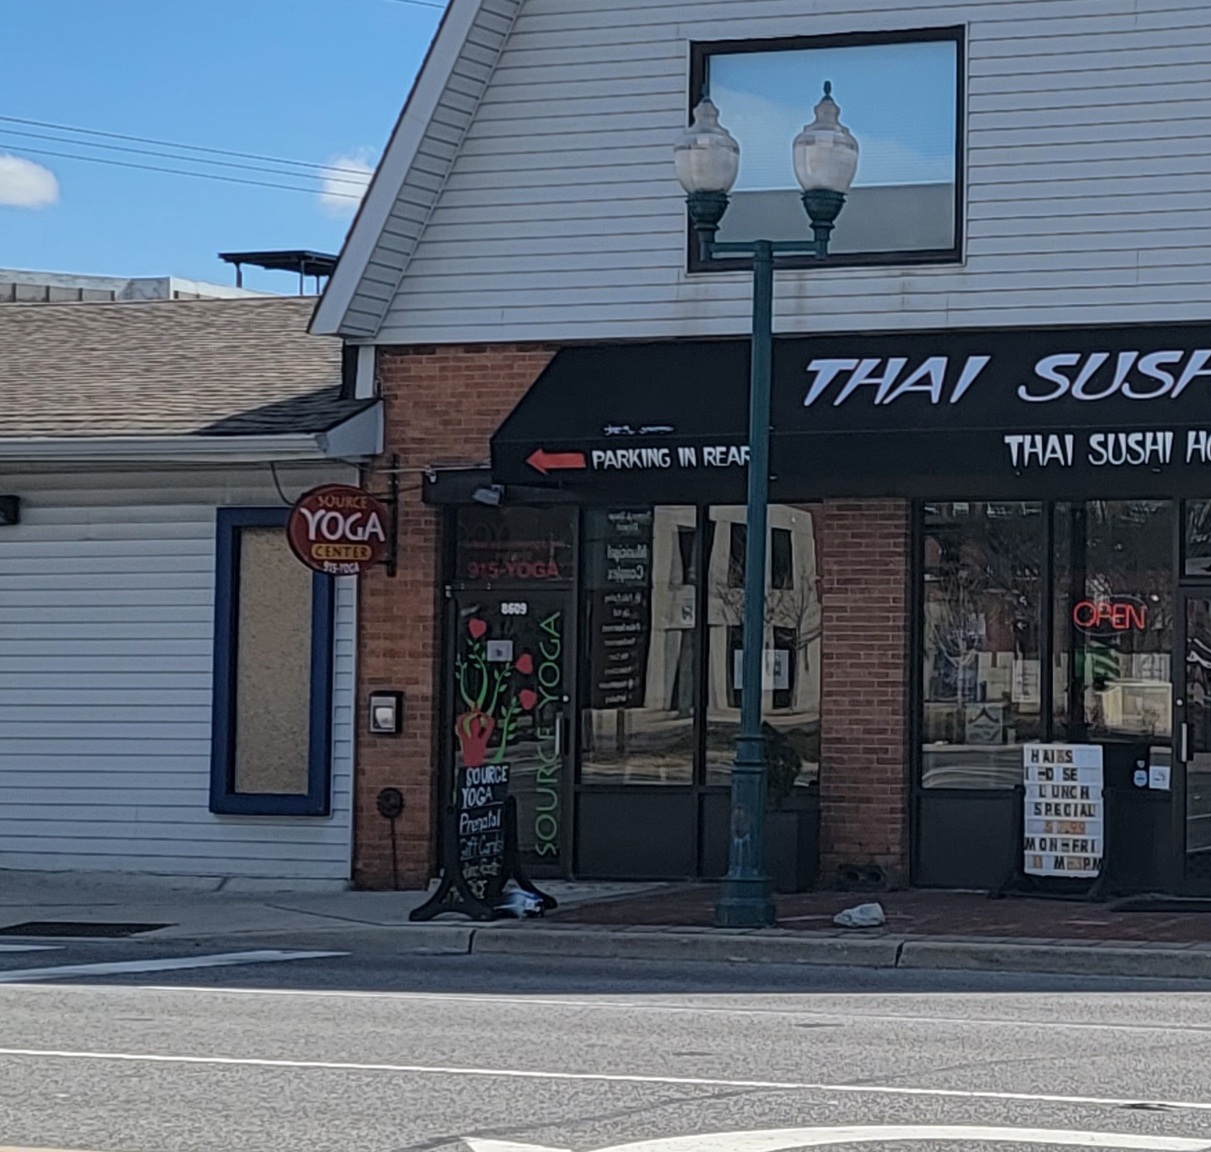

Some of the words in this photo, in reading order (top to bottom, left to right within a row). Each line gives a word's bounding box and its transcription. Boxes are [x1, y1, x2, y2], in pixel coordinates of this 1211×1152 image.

[803, 356, 991, 406] THAI
[592, 448, 671, 469] PARKING
[678, 447, 697, 468] IN
[1004, 434, 1074, 467] THAI
[1088, 432, 1174, 465] SUSHI
[318, 496, 367, 508] SOURCE
[300, 508, 386, 542] YOGA
[315, 546, 369, 558] CENTER
[501, 602, 527, 615] 8609
[1073, 601, 1145, 630] OPEN
[538, 611, 561, 709] YOGA
[466, 765, 509, 786] SOURCE
[461, 786, 493, 809] YOGA
[535, 727, 561, 856] SOURCE
[1039, 785, 1090, 799] LUNCH
[1034, 803, 1096, 817] SPECIAL
[459, 809, 501, 836] Prenatal
